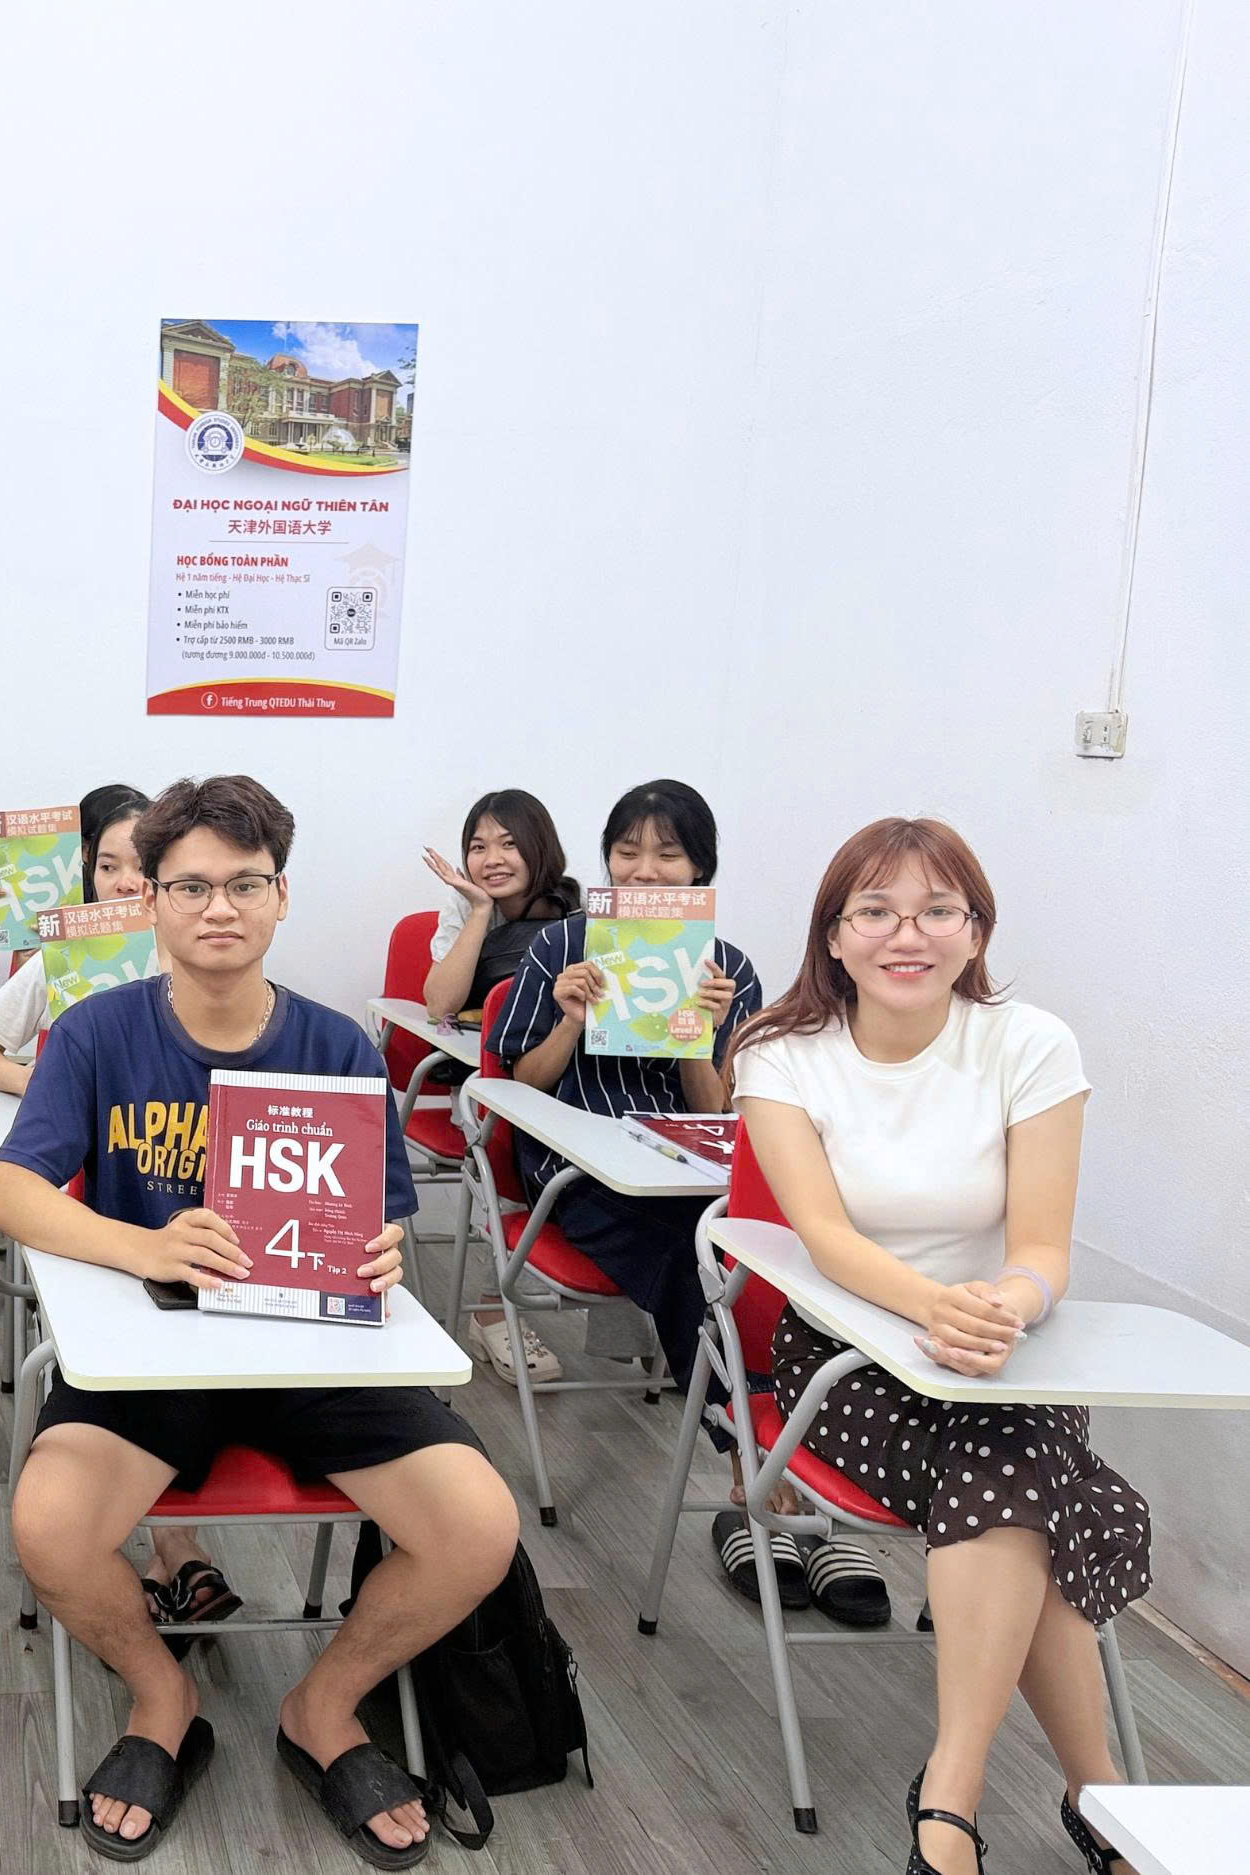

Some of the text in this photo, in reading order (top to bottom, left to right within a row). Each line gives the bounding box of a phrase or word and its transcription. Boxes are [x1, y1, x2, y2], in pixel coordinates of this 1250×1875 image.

[172, 498, 389, 514] ĐẠI HỌC NGOẠI NGỮ THIÊN TÂN
[228, 519, 332, 536] 天津外国语大学
[177, 556, 198, 568] HỌC
[230, 554, 258, 567] TOÀN
[260, 554, 289, 567] PHẦN
[204, 590, 217, 600] học
[221, 697, 244, 710] Tiếng
[244, 697, 268, 710] Trung
[588, 891, 612, 914] 新
[38, 903, 142, 937] 新 汉语水平考试
[267, 1104, 313, 1119] 标准教程
[108, 1101, 208, 1153] ALPHA
[246, 1118, 333, 1137] Giáo trình chuẩn
[229, 1134, 346, 1197] HSK
